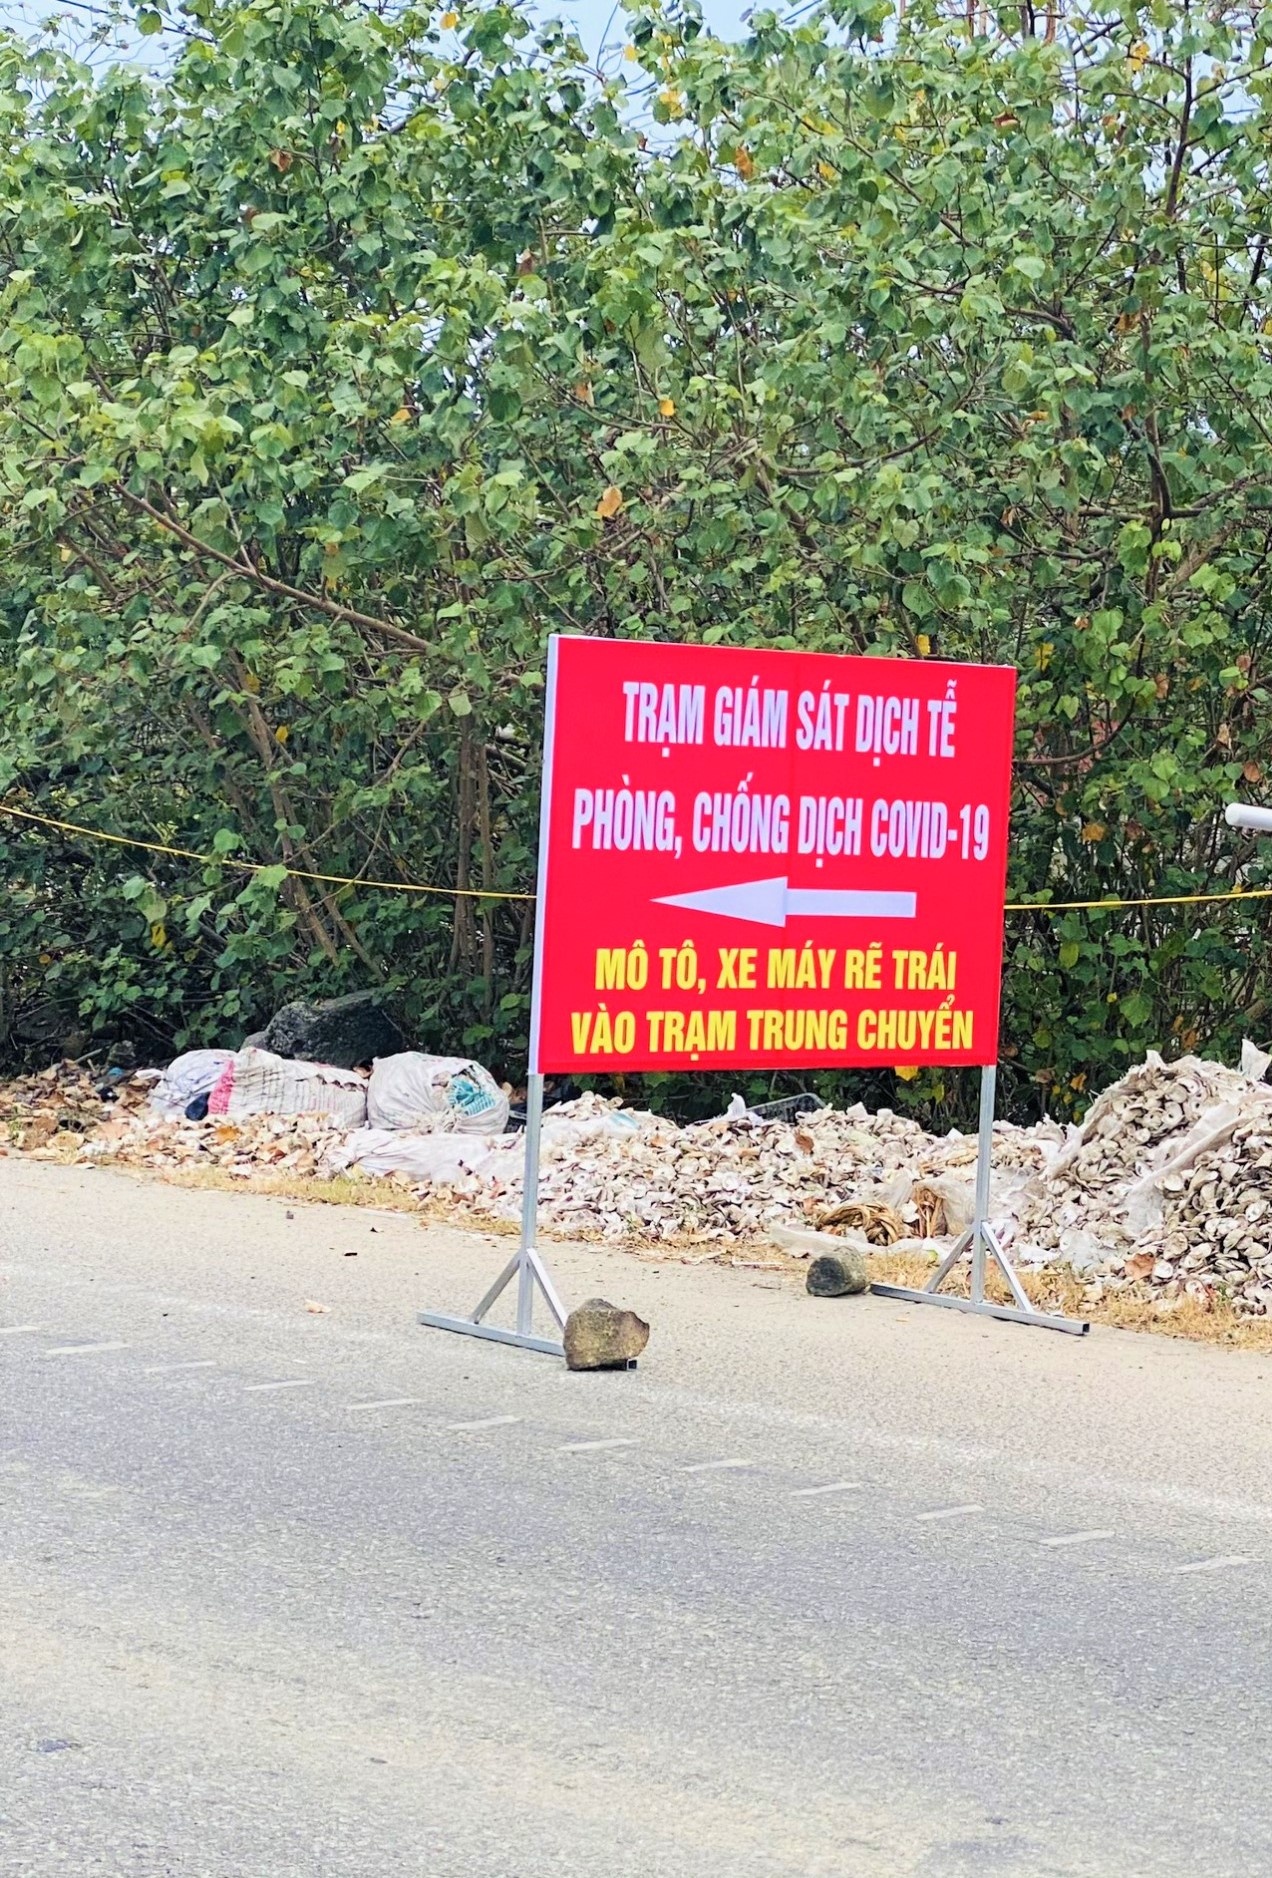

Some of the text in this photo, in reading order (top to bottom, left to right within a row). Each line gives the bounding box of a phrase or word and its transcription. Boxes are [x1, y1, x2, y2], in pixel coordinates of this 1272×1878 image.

[622, 674, 957, 767] TRẠM GIÁM SÁT DỊCH TỄ
[572, 771, 990, 868] PHÒNG, CHỐNG DỊCH COVID-19
[594, 938, 957, 995] MÔ TÔ, XE MÁY RẼ TRÁI
[570, 994, 974, 1062] VÀO TRẠM TRUNG CHUYỂN
